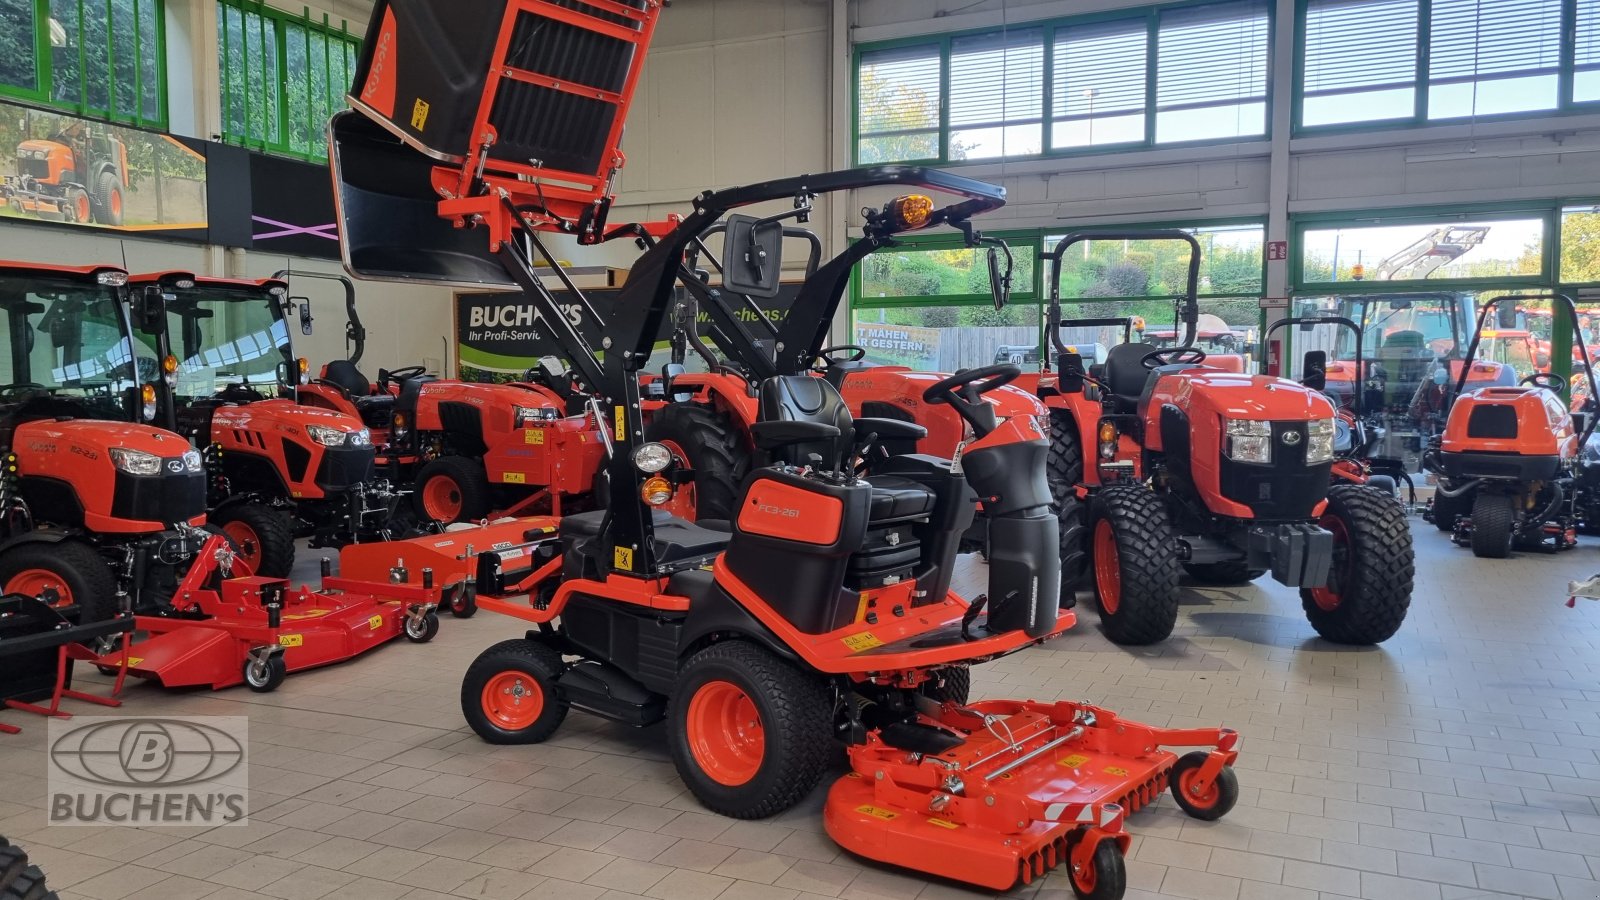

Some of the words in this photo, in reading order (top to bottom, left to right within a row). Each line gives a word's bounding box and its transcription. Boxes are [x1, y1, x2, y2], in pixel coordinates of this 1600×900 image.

[364, 31, 391, 98] Kubota
[469, 303, 583, 328] BUCH'S
[468, 330, 482, 341] Ihr
[868, 326, 909, 340] MÄHEN
[871, 338, 924, 351] GESTERN
[1011, 355, 1022, 365] 40
[758, 504, 800, 518] FC3-261
